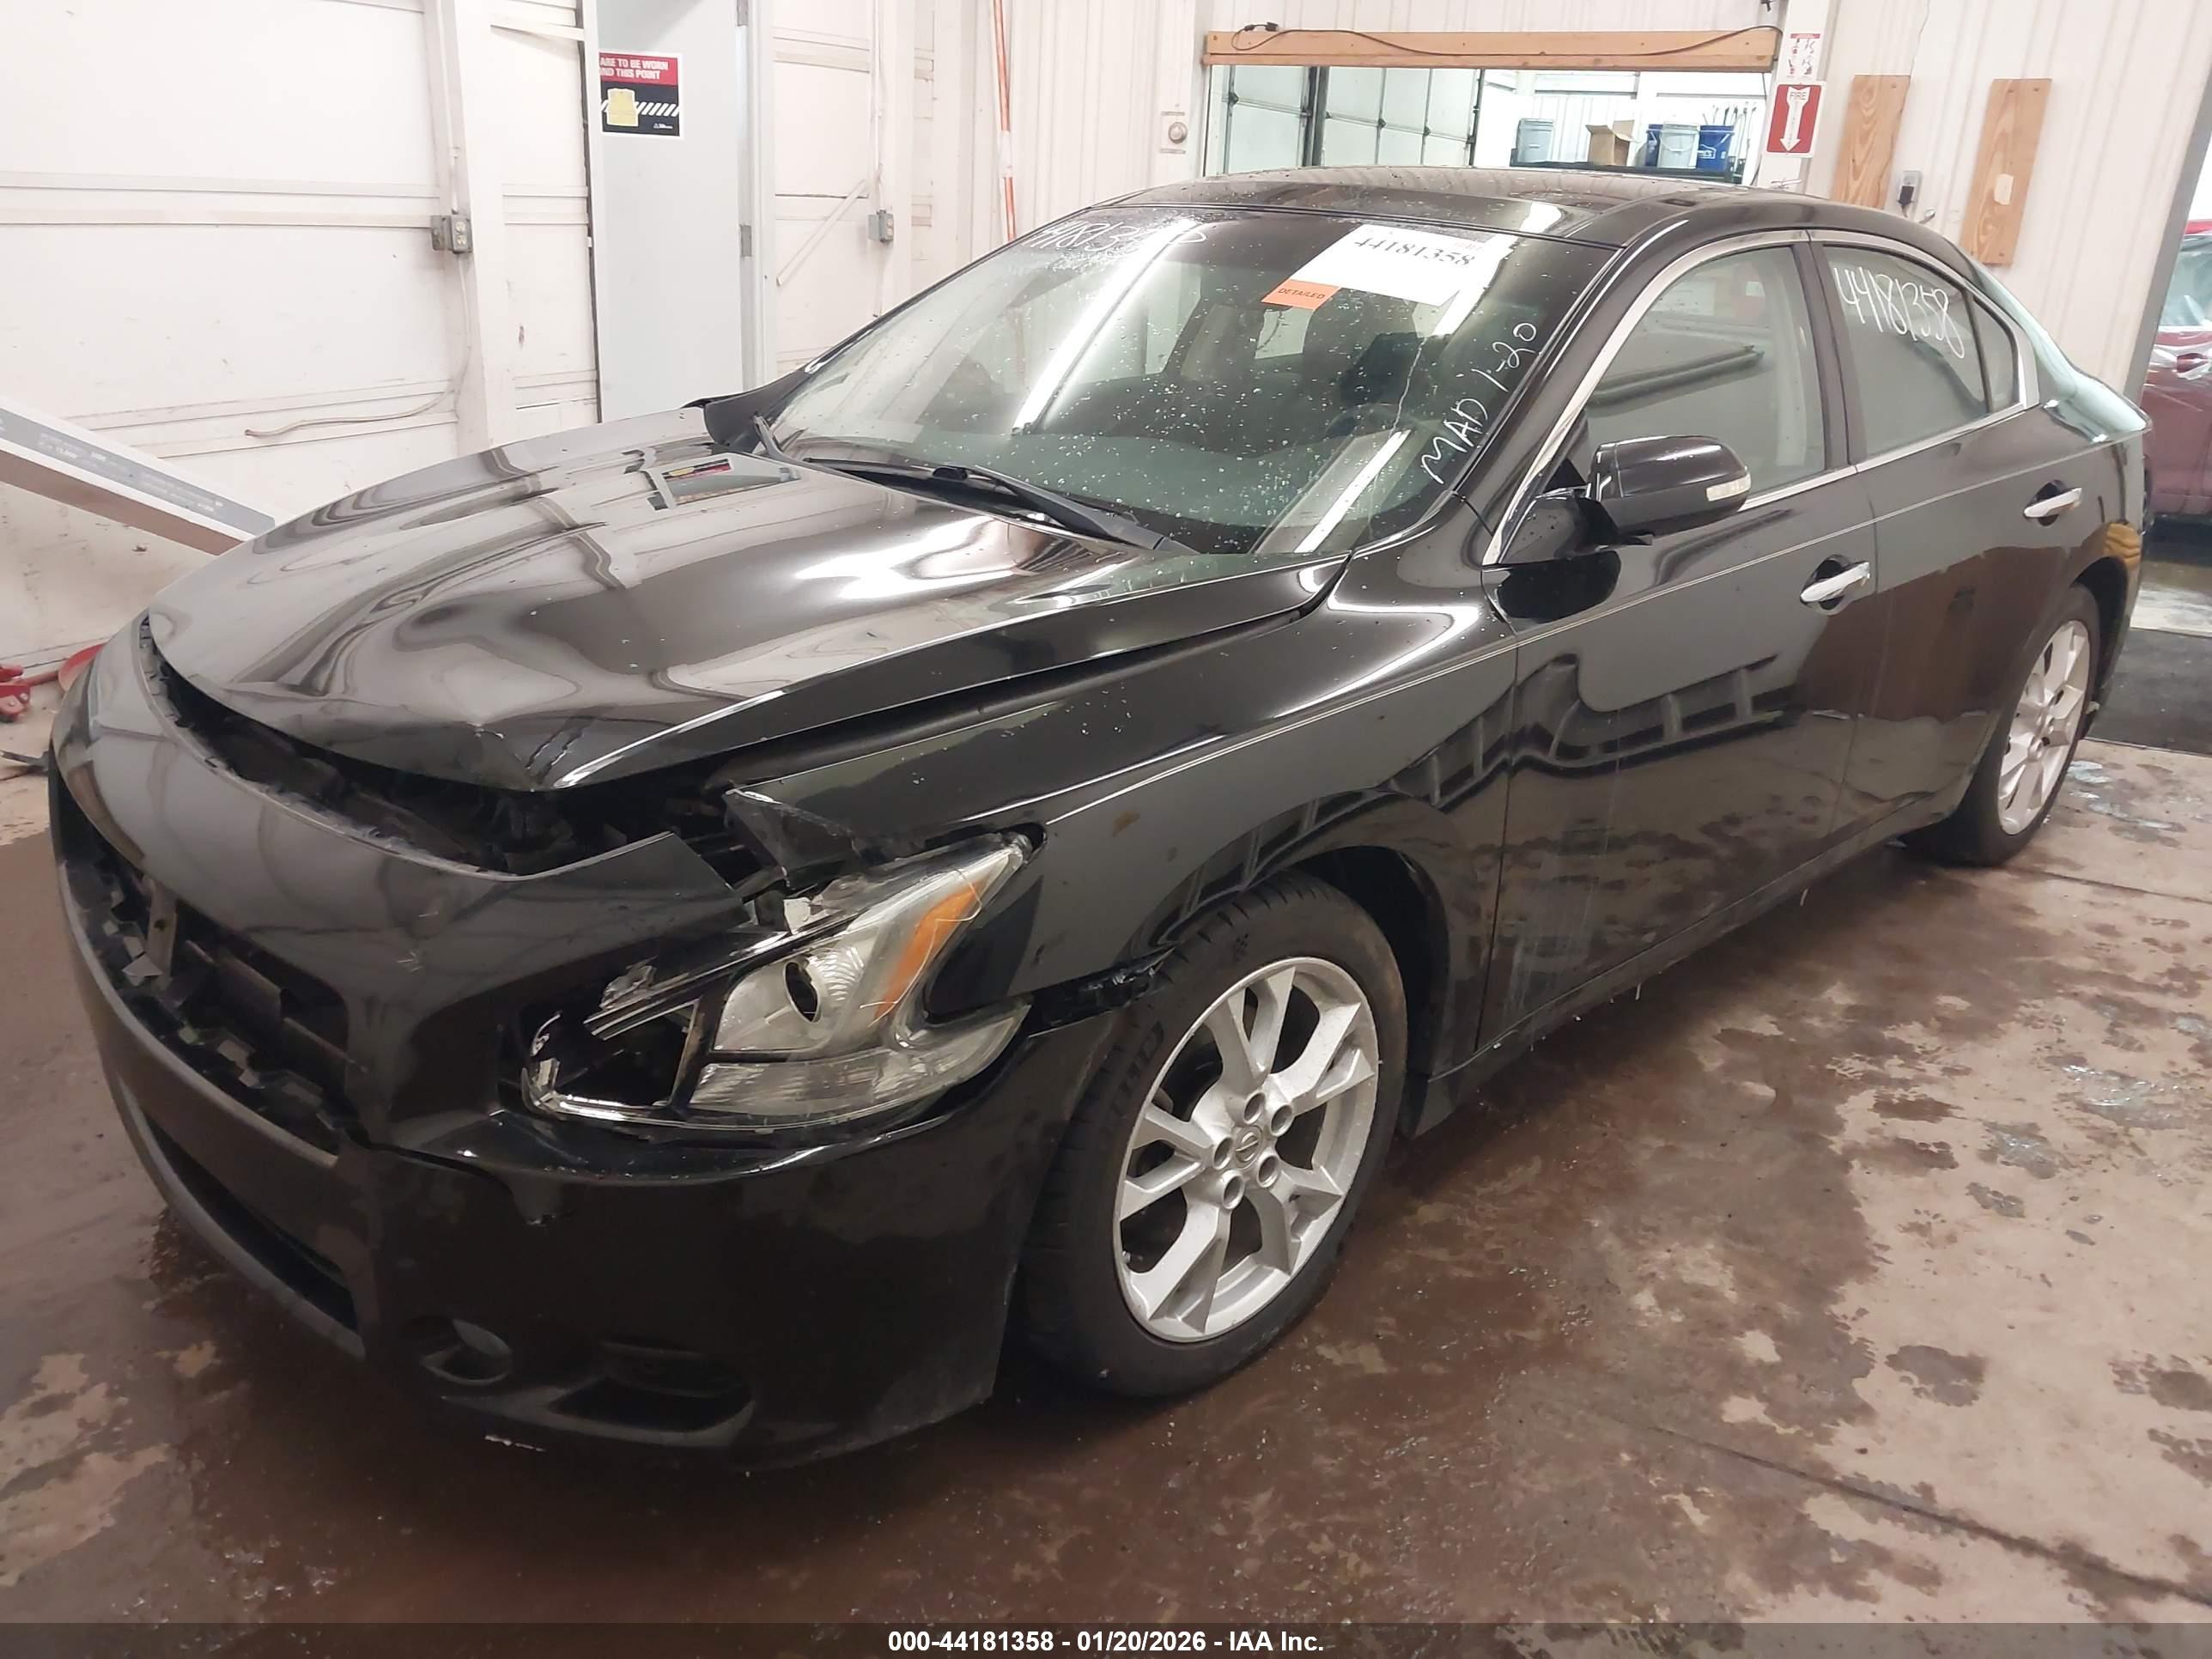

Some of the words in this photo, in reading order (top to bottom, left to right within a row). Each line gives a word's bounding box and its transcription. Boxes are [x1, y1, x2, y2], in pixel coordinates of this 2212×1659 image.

[600, 58, 617, 67] ARE
[617, 58, 629, 68] TO
[629, 60, 641, 70] BE
[641, 60, 669, 70] WORN
[616, 69, 635, 78] THIS
[635, 70, 661, 80] POINT
[1790, 91, 1808, 100] FIRE
[1354, 237, 1476, 267] 44181358
[1278, 288, 1326, 300] DETAILED
[1833, 266, 1966, 359] 44181358
[1421, 398, 1489, 485] MAD
[1470, 322, 1538, 393] 1-20
